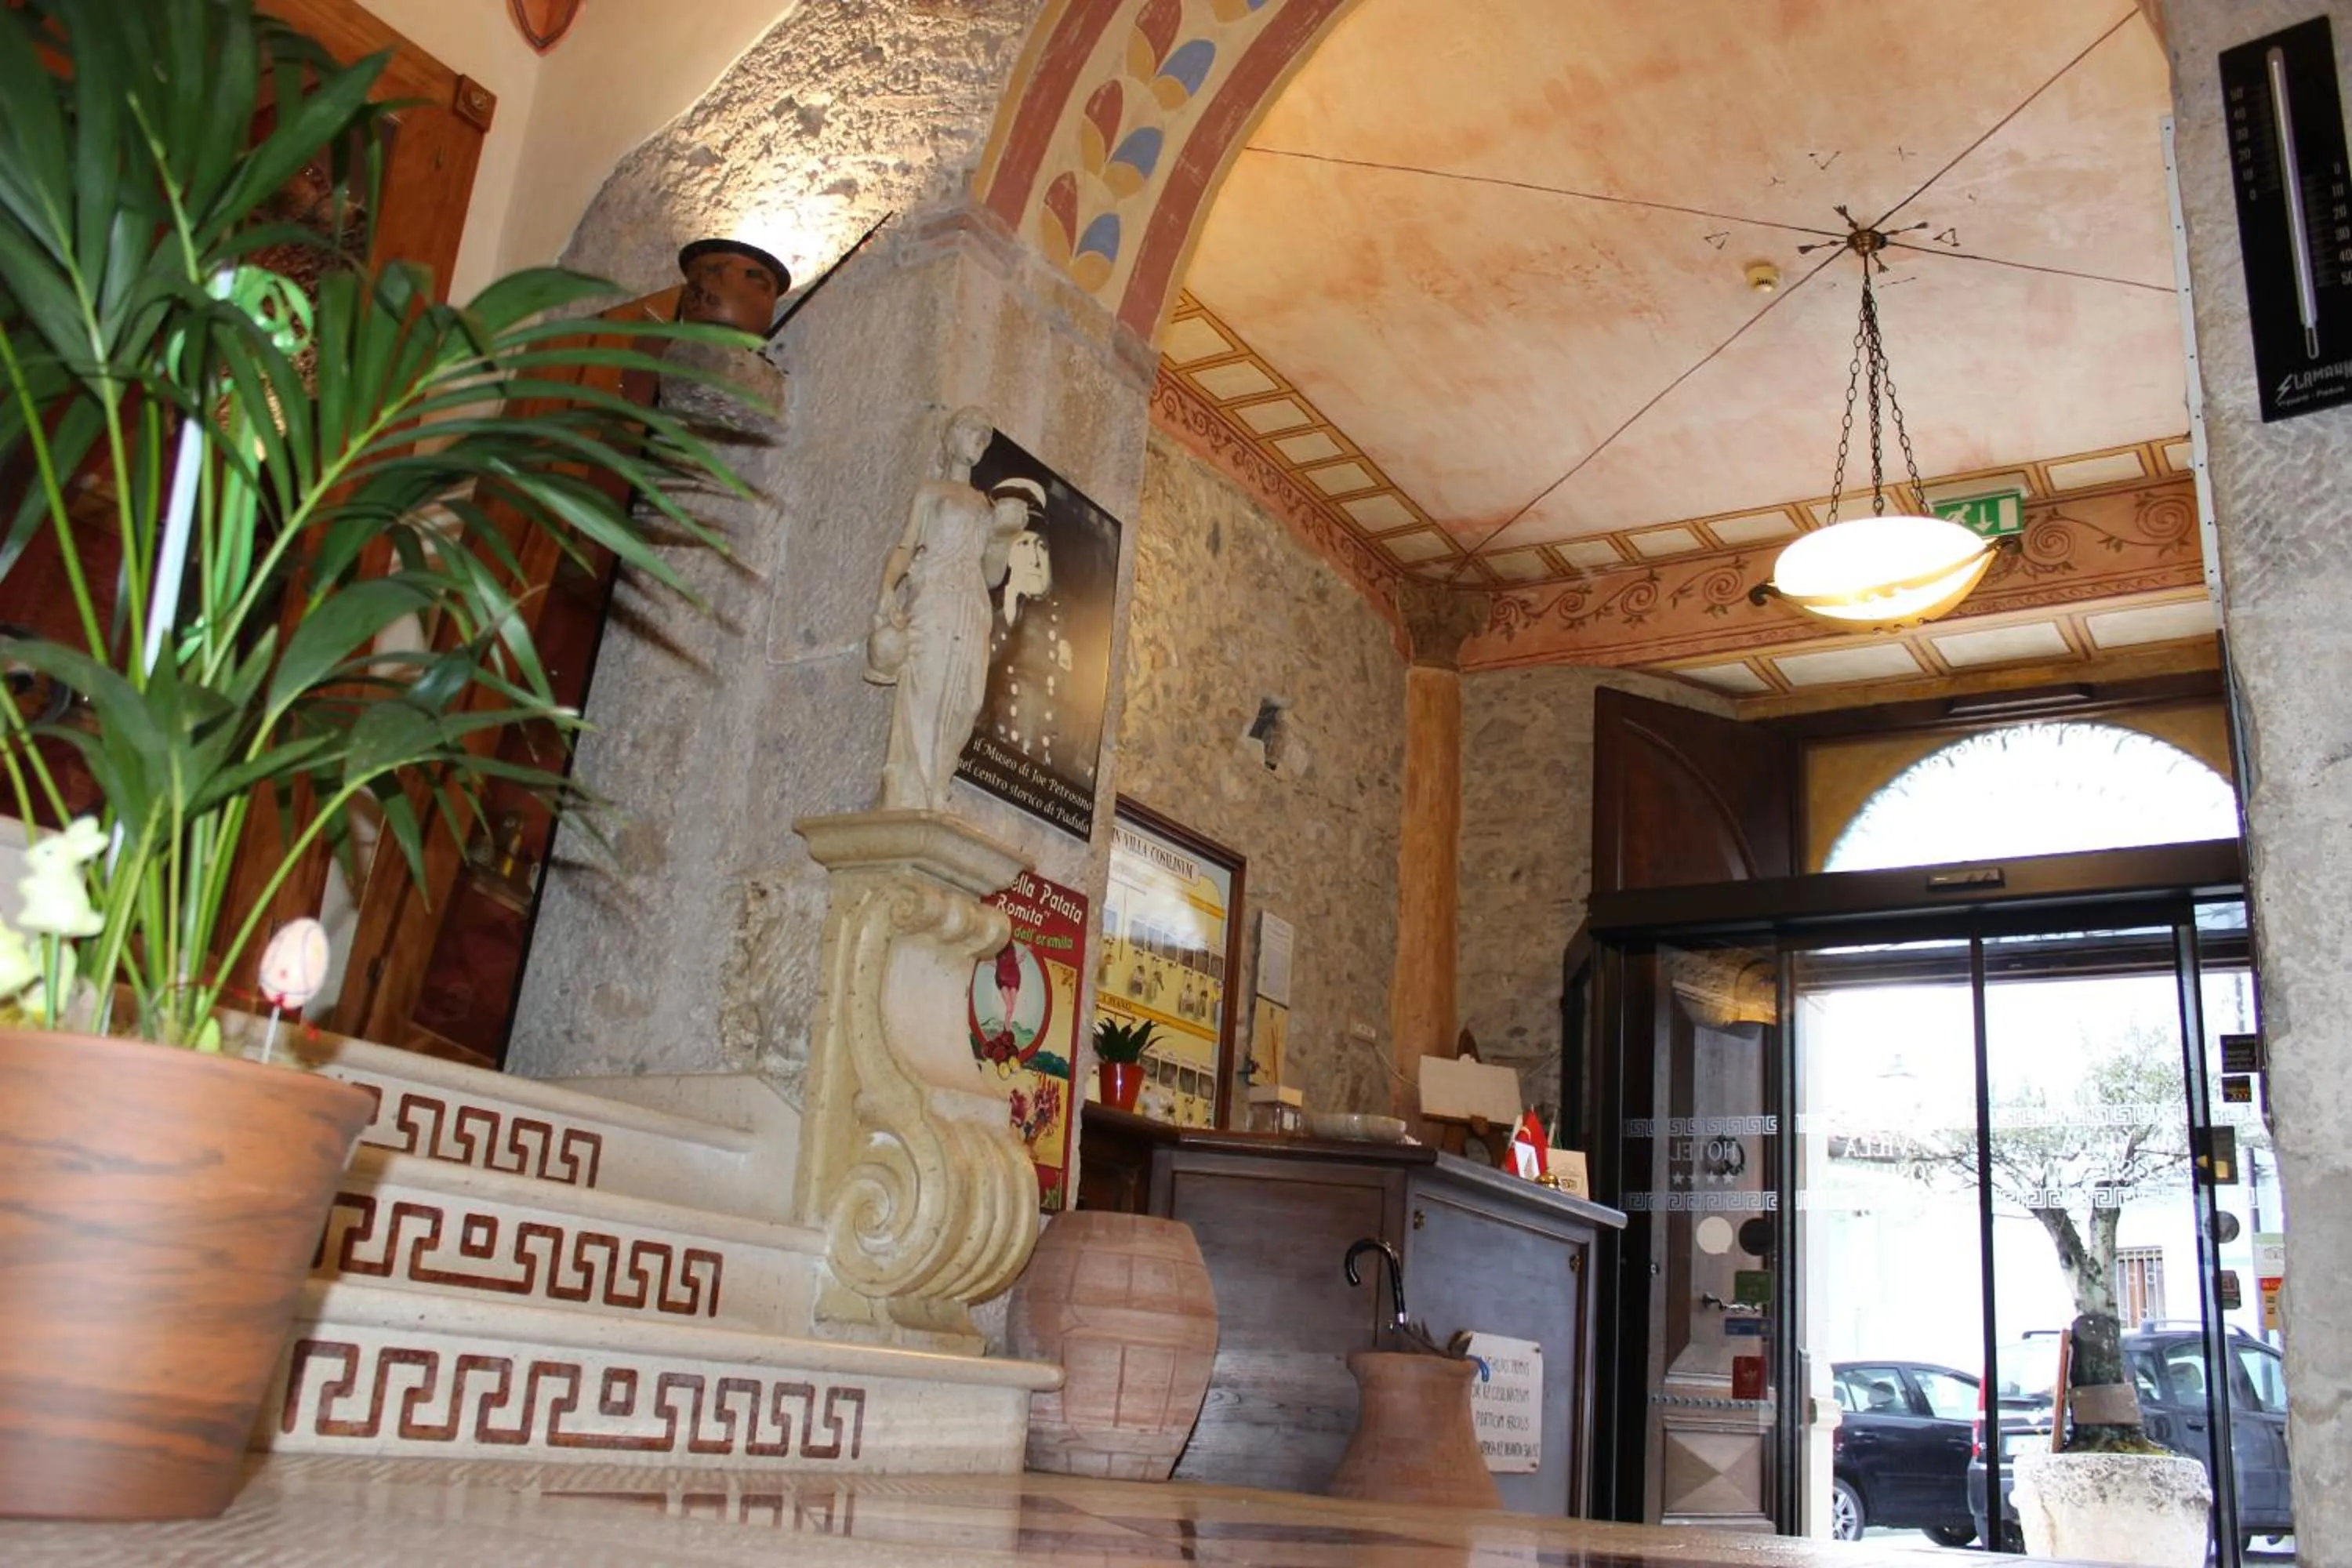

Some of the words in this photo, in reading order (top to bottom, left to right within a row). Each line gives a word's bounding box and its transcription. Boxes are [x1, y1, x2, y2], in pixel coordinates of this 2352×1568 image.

[2238, 147, 2251, 163] 20
[2249, 188, 2256, 201] 0
[2332, 183, 2344, 197] 10
[2332, 204, 2347, 220] 20
[983, 744, 1017, 771] Museo
[1018, 763, 1029, 777] di
[1031, 768, 1047, 786] Joe
[1048, 778, 1092, 811] Petrosino
[973, 767, 1008, 790] centro
[1009, 783, 1043, 808] storico
[1044, 800, 1054, 815] di
[1055, 806, 1090, 833] Padula
[1010, 873, 1036, 898] ella
[1039, 884, 1083, 925] Patata
